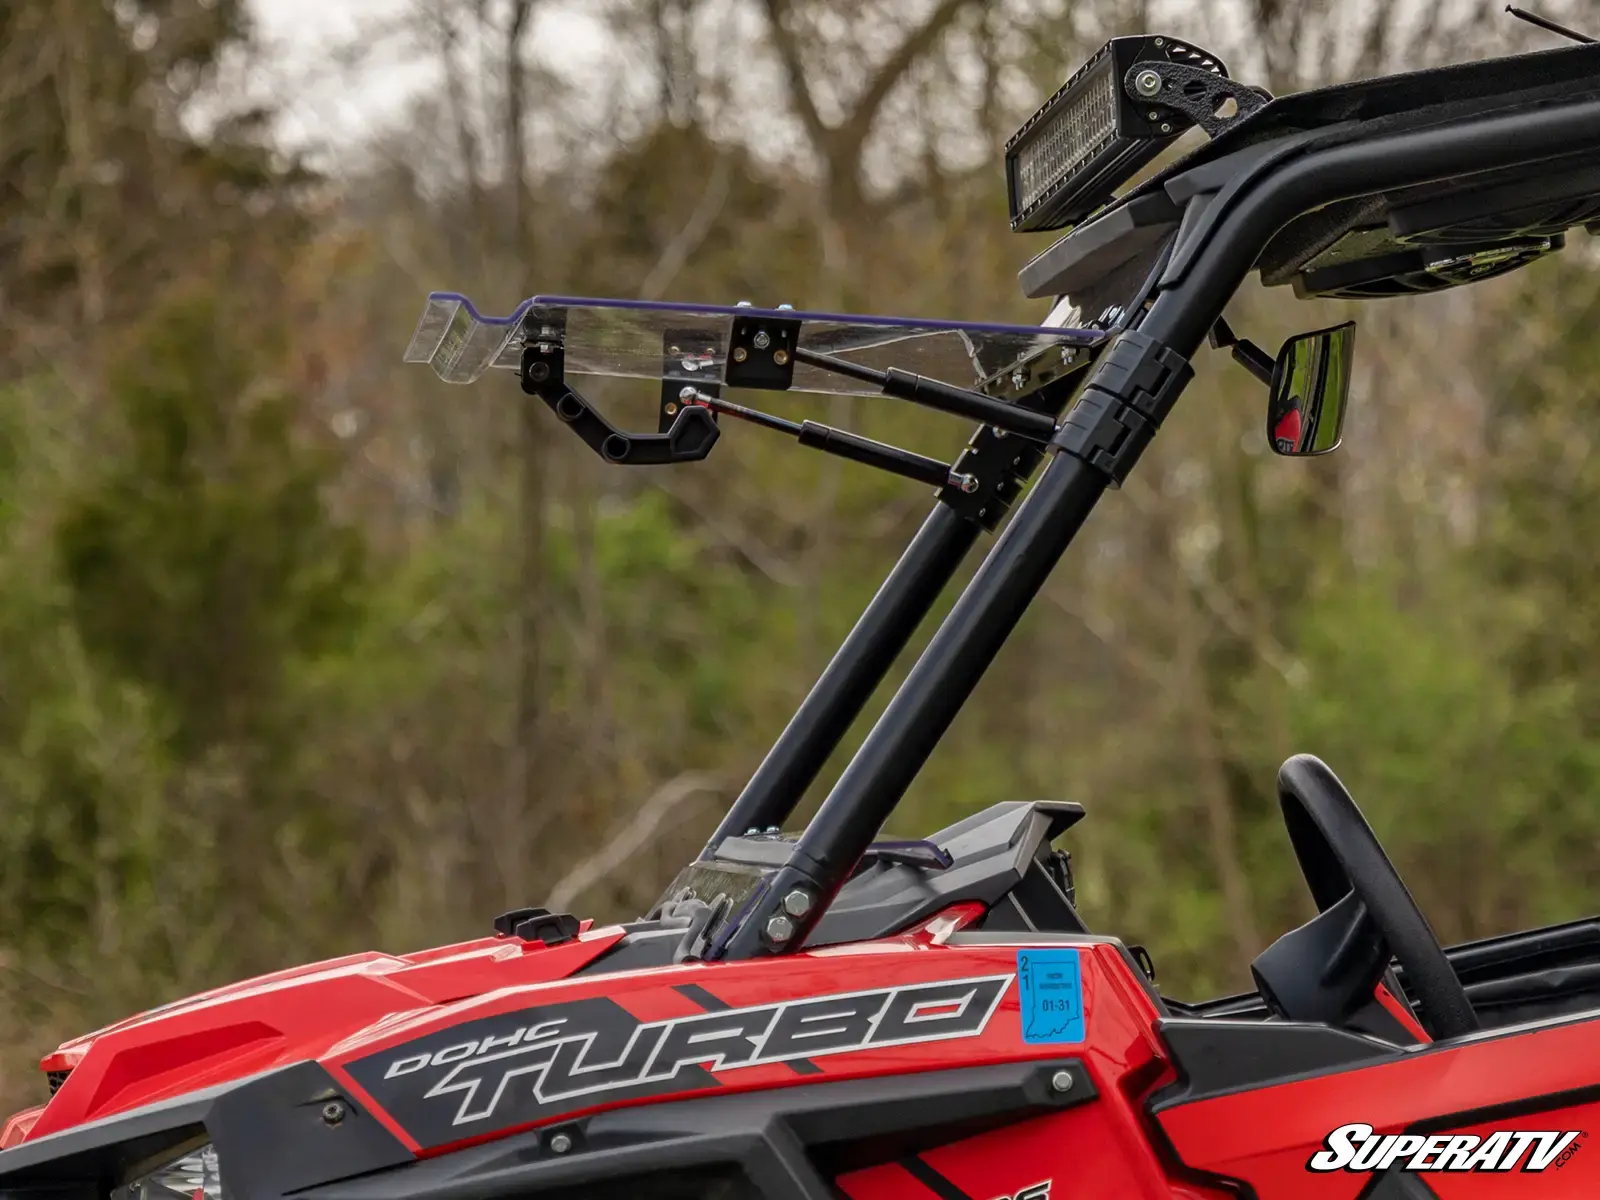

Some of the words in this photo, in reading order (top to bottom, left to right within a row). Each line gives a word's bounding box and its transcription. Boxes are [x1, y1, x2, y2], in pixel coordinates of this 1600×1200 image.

[1042, 999, 1070, 1012] 01-31
[384, 1018, 568, 1079] DOHC
[424, 973, 1017, 1126] TURBO
